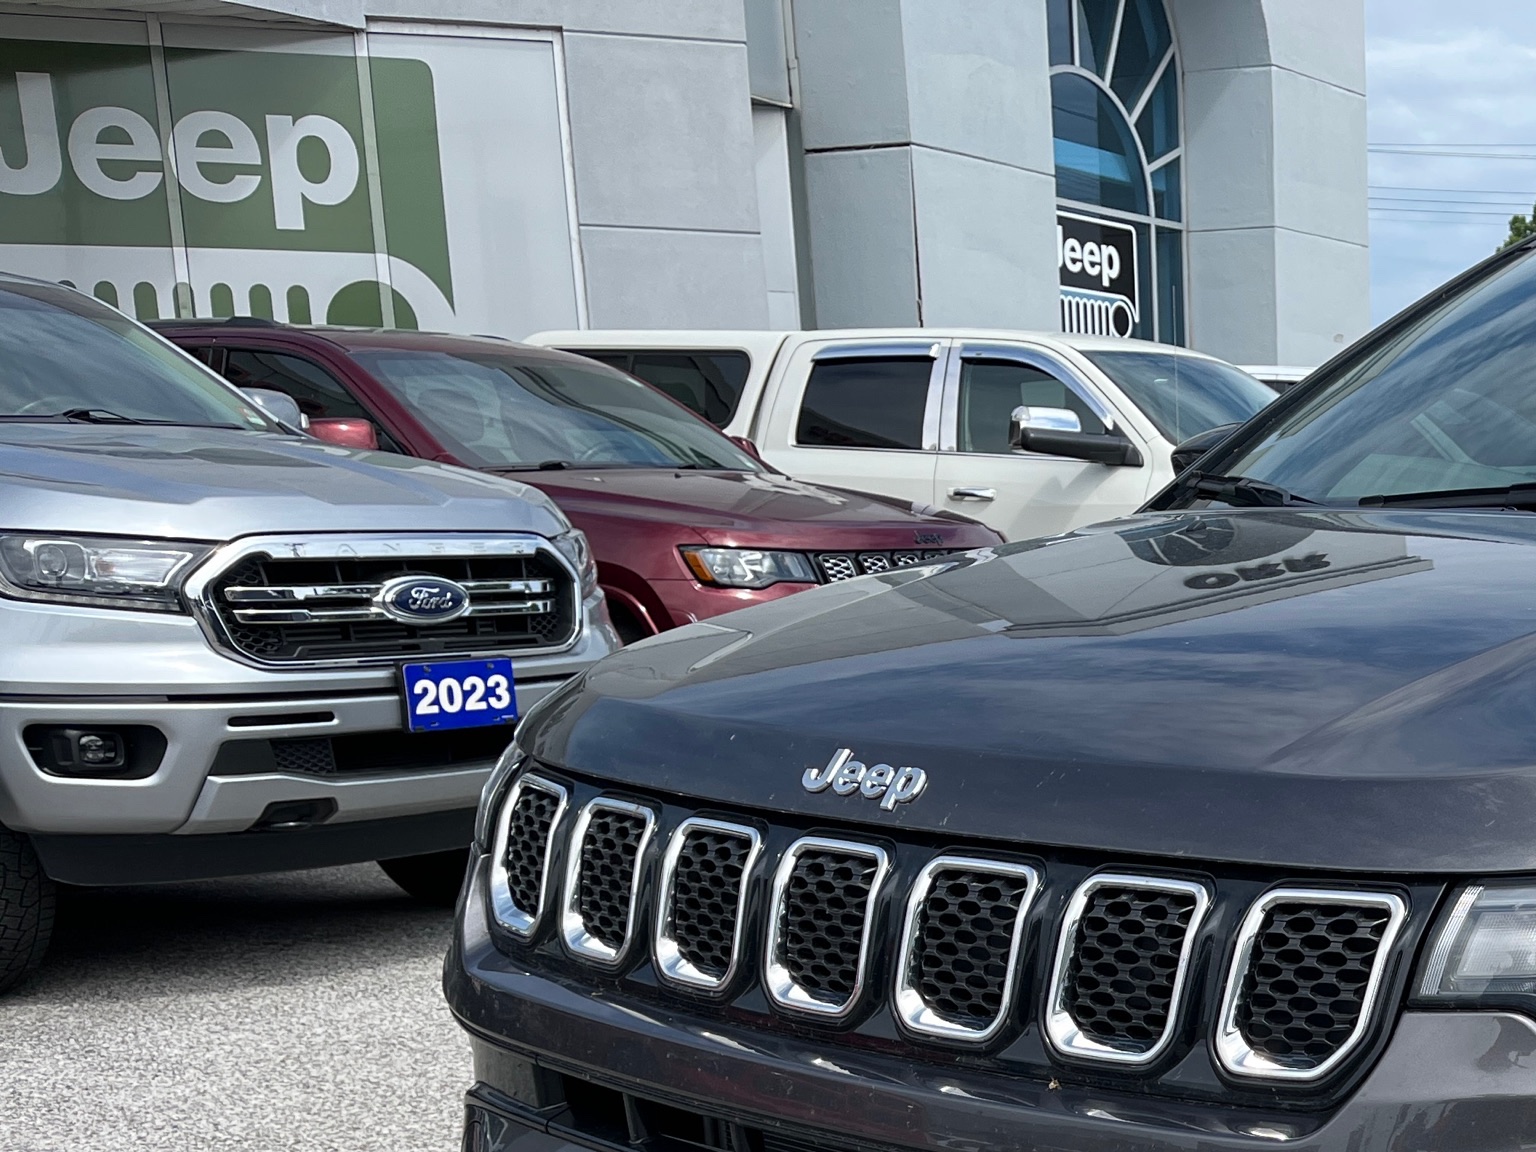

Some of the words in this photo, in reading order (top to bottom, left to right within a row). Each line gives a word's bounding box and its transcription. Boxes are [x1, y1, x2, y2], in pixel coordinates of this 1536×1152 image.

[0, 71, 360, 231] Jeep
[408, 586, 454, 610] Ford
[413, 674, 512, 715] 2023
[801, 748, 928, 812] Jeep
